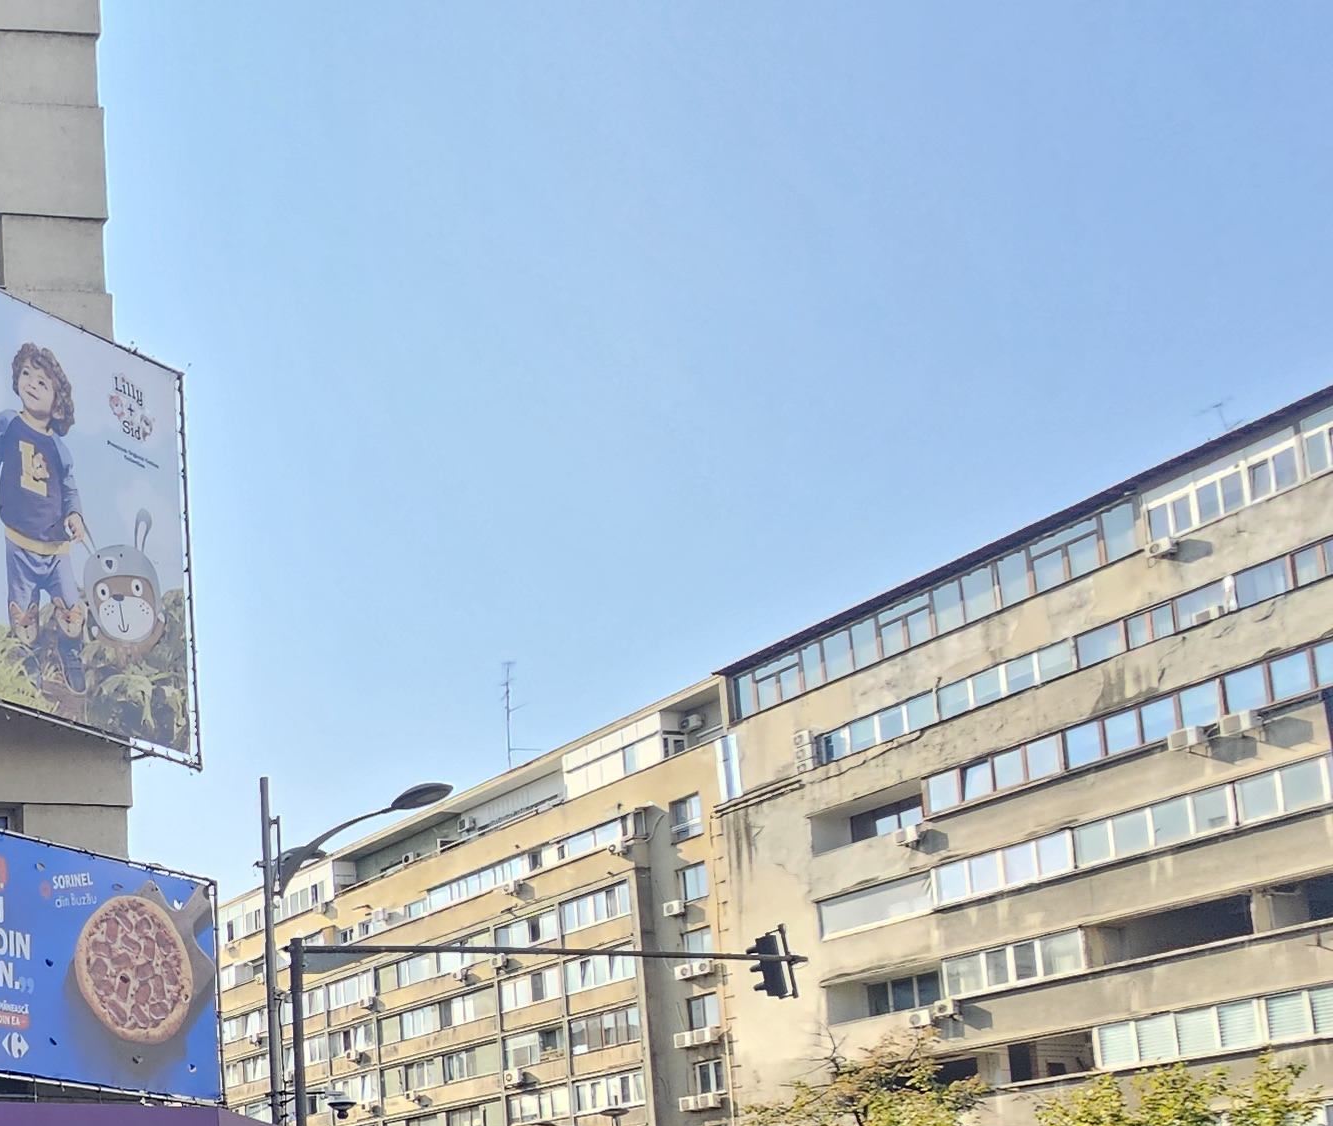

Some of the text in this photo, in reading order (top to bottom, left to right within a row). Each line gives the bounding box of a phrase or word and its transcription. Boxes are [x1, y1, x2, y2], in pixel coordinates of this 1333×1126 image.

[114, 376, 143, 407] Lilly
[122, 420, 141, 440] Sid
[52, 872, 93, 890] SORINEL
[11, 1016, 21, 1026] EA
